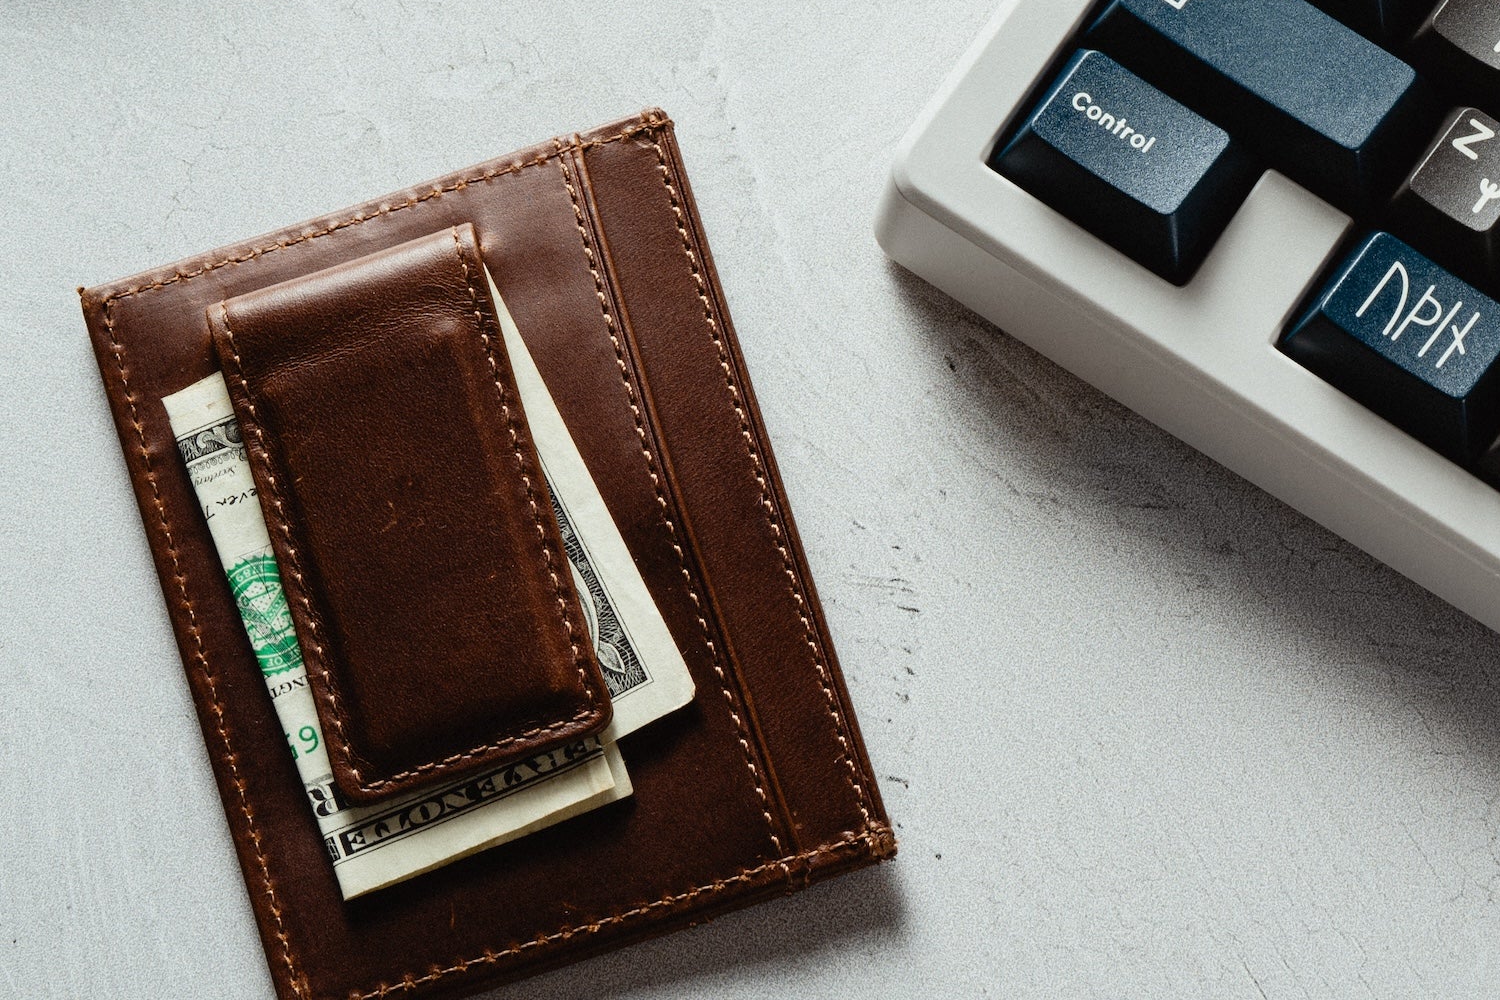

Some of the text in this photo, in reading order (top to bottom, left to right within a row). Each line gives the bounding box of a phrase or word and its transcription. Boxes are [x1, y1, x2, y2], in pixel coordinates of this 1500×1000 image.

[1072, 92, 1157, 154] Control
[1452, 118, 1496, 161] Z
[346, 785, 469, 853] NOTE
